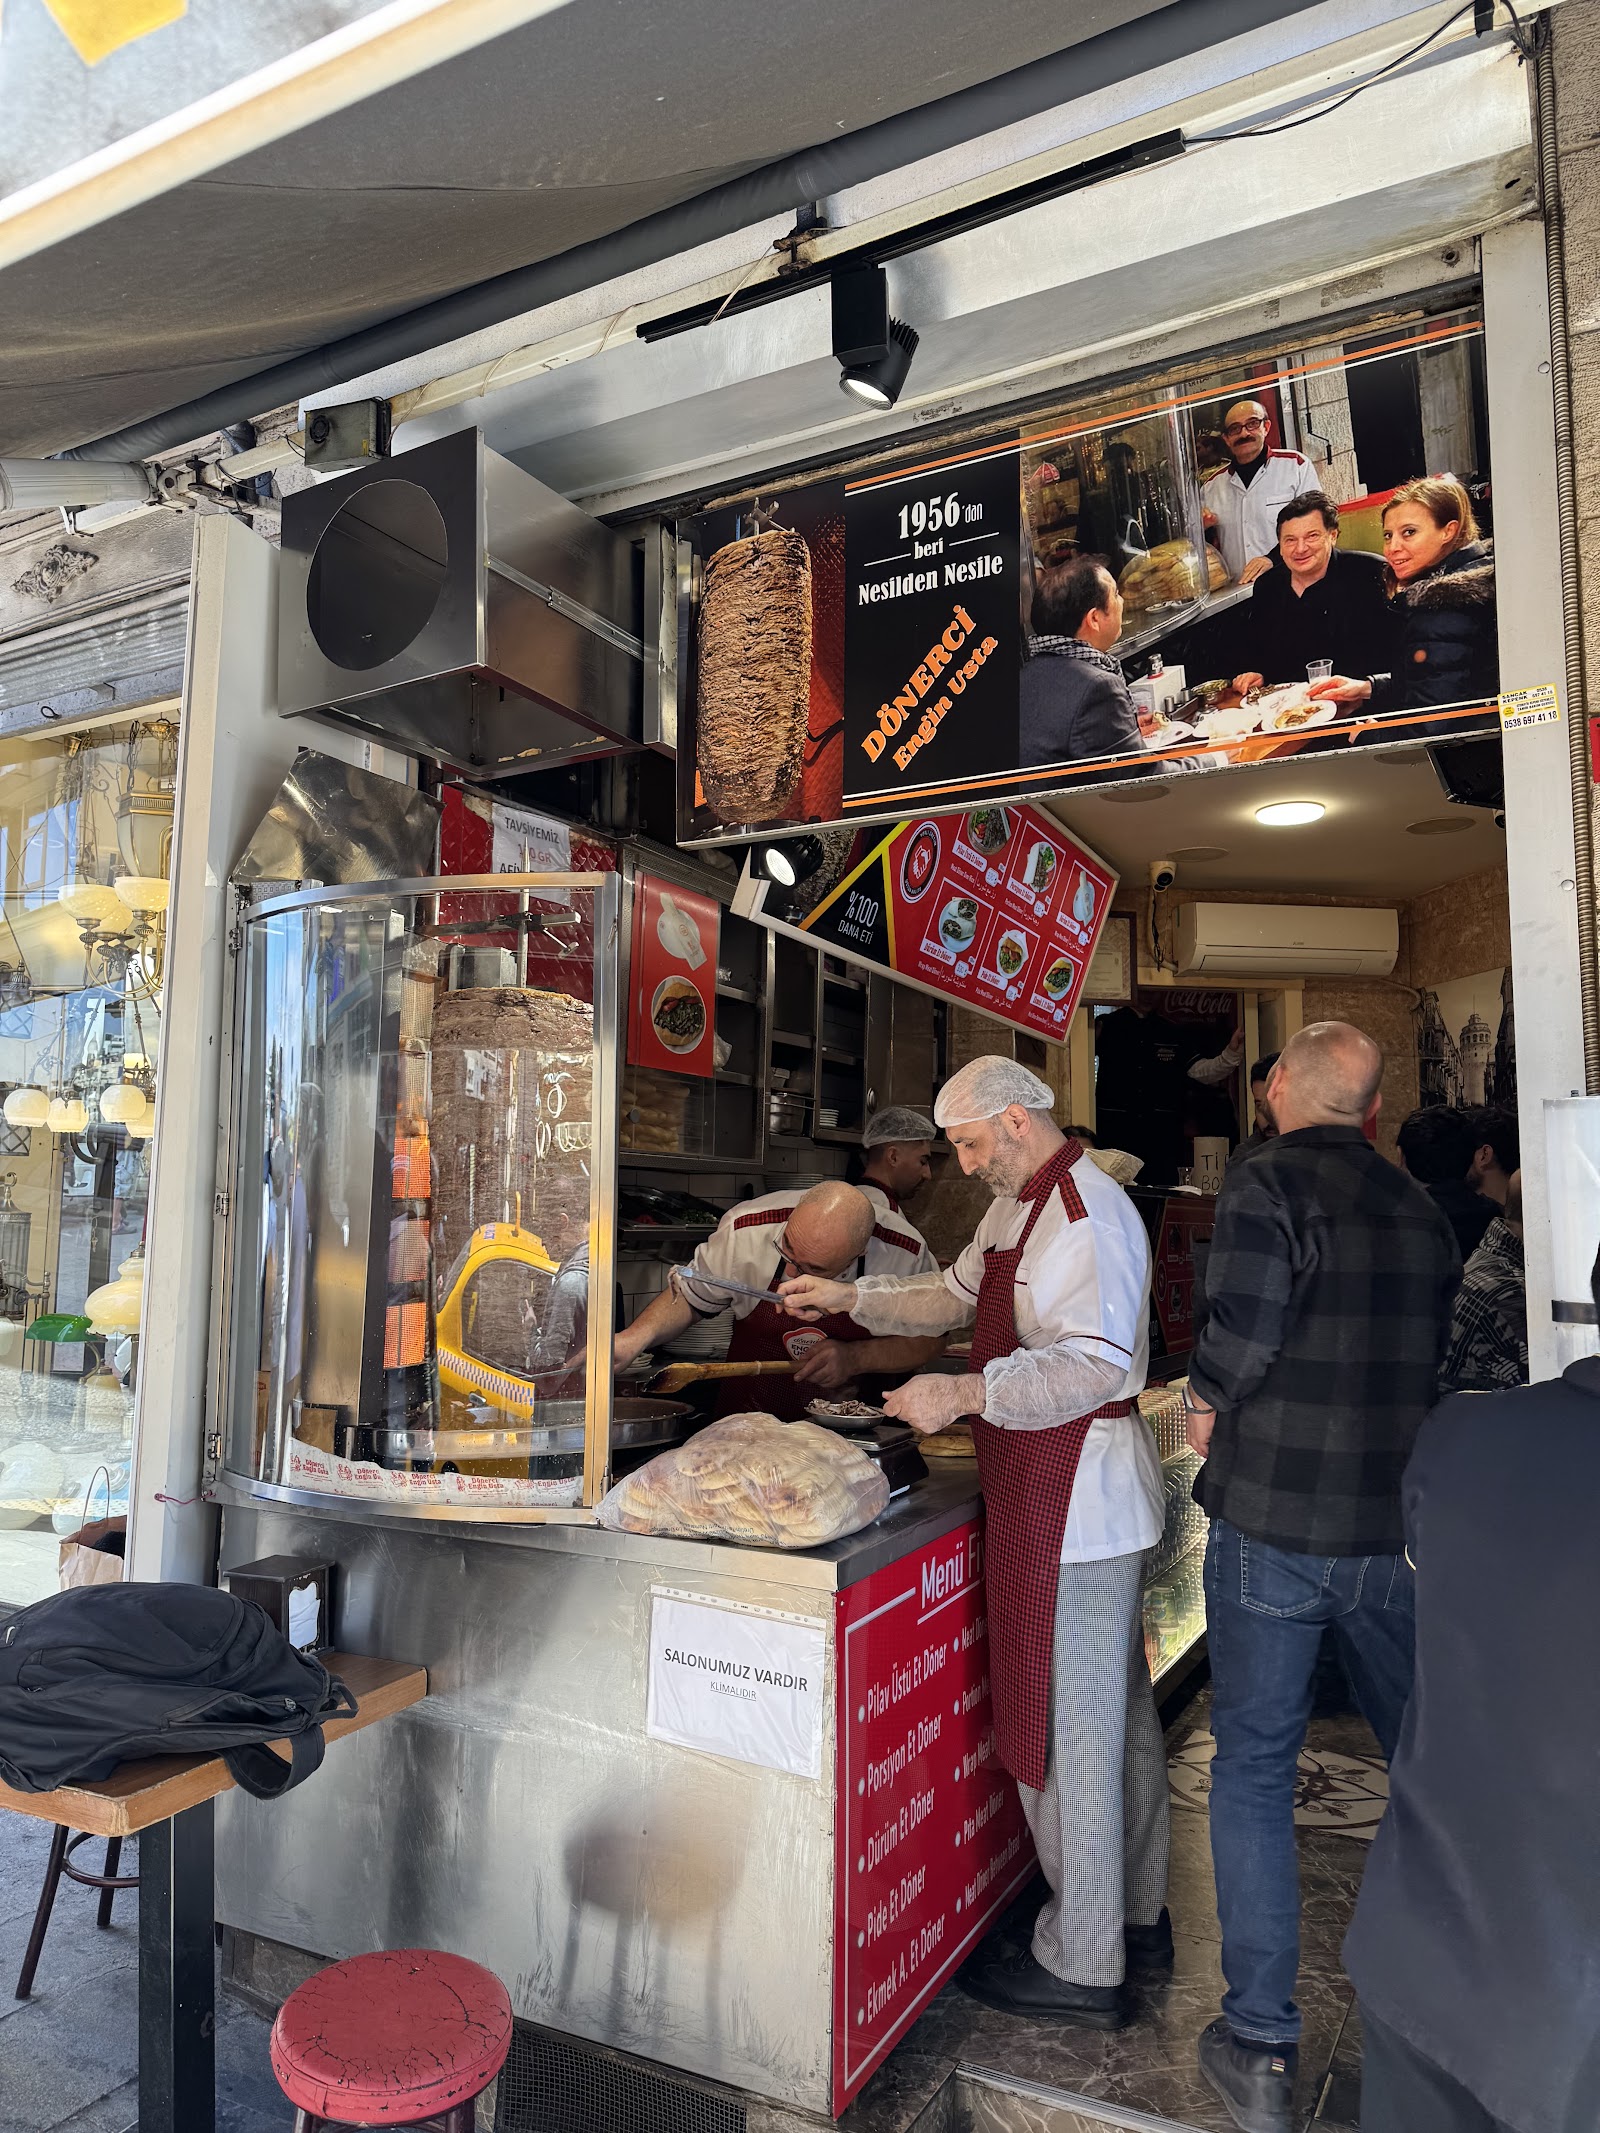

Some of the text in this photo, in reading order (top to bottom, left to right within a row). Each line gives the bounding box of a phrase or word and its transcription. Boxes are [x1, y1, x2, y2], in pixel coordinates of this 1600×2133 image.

[914, 537, 944, 559] beri
[858, 554, 1003, 606] Nesilden Nesile
[861, 604, 977, 763] DÖNERCİ
[892, 636, 999, 772] Engin Usta
[1504, 710, 1557, 728] 0538 697 41 18
[504, 816, 560, 844] TAVSİYEMİZ
[518, 844, 551, 863] 10 GR
[844, 891, 879, 927] %100
[838, 920, 873, 944] DANA ETİ
[1202, 1175, 1223, 1190] BO
[922, 1541, 964, 1609] Menü
[961, 1622, 975, 1651] Meat
[664, 1647, 808, 1692] SALONUMUZ VARDIR
[710, 1681, 757, 1700] KLİMALIDIR
[867, 1643, 948, 1723] Pilav Üstü Et Döner
[867, 1713, 942, 1798] Porsiyon Et Döner
[868, 1787, 935, 1873] Dürüm Et Döner
[867, 1864, 926, 1948] Pide Et Döner
[867, 1913, 946, 2025] Ekmek A. Et Döner
